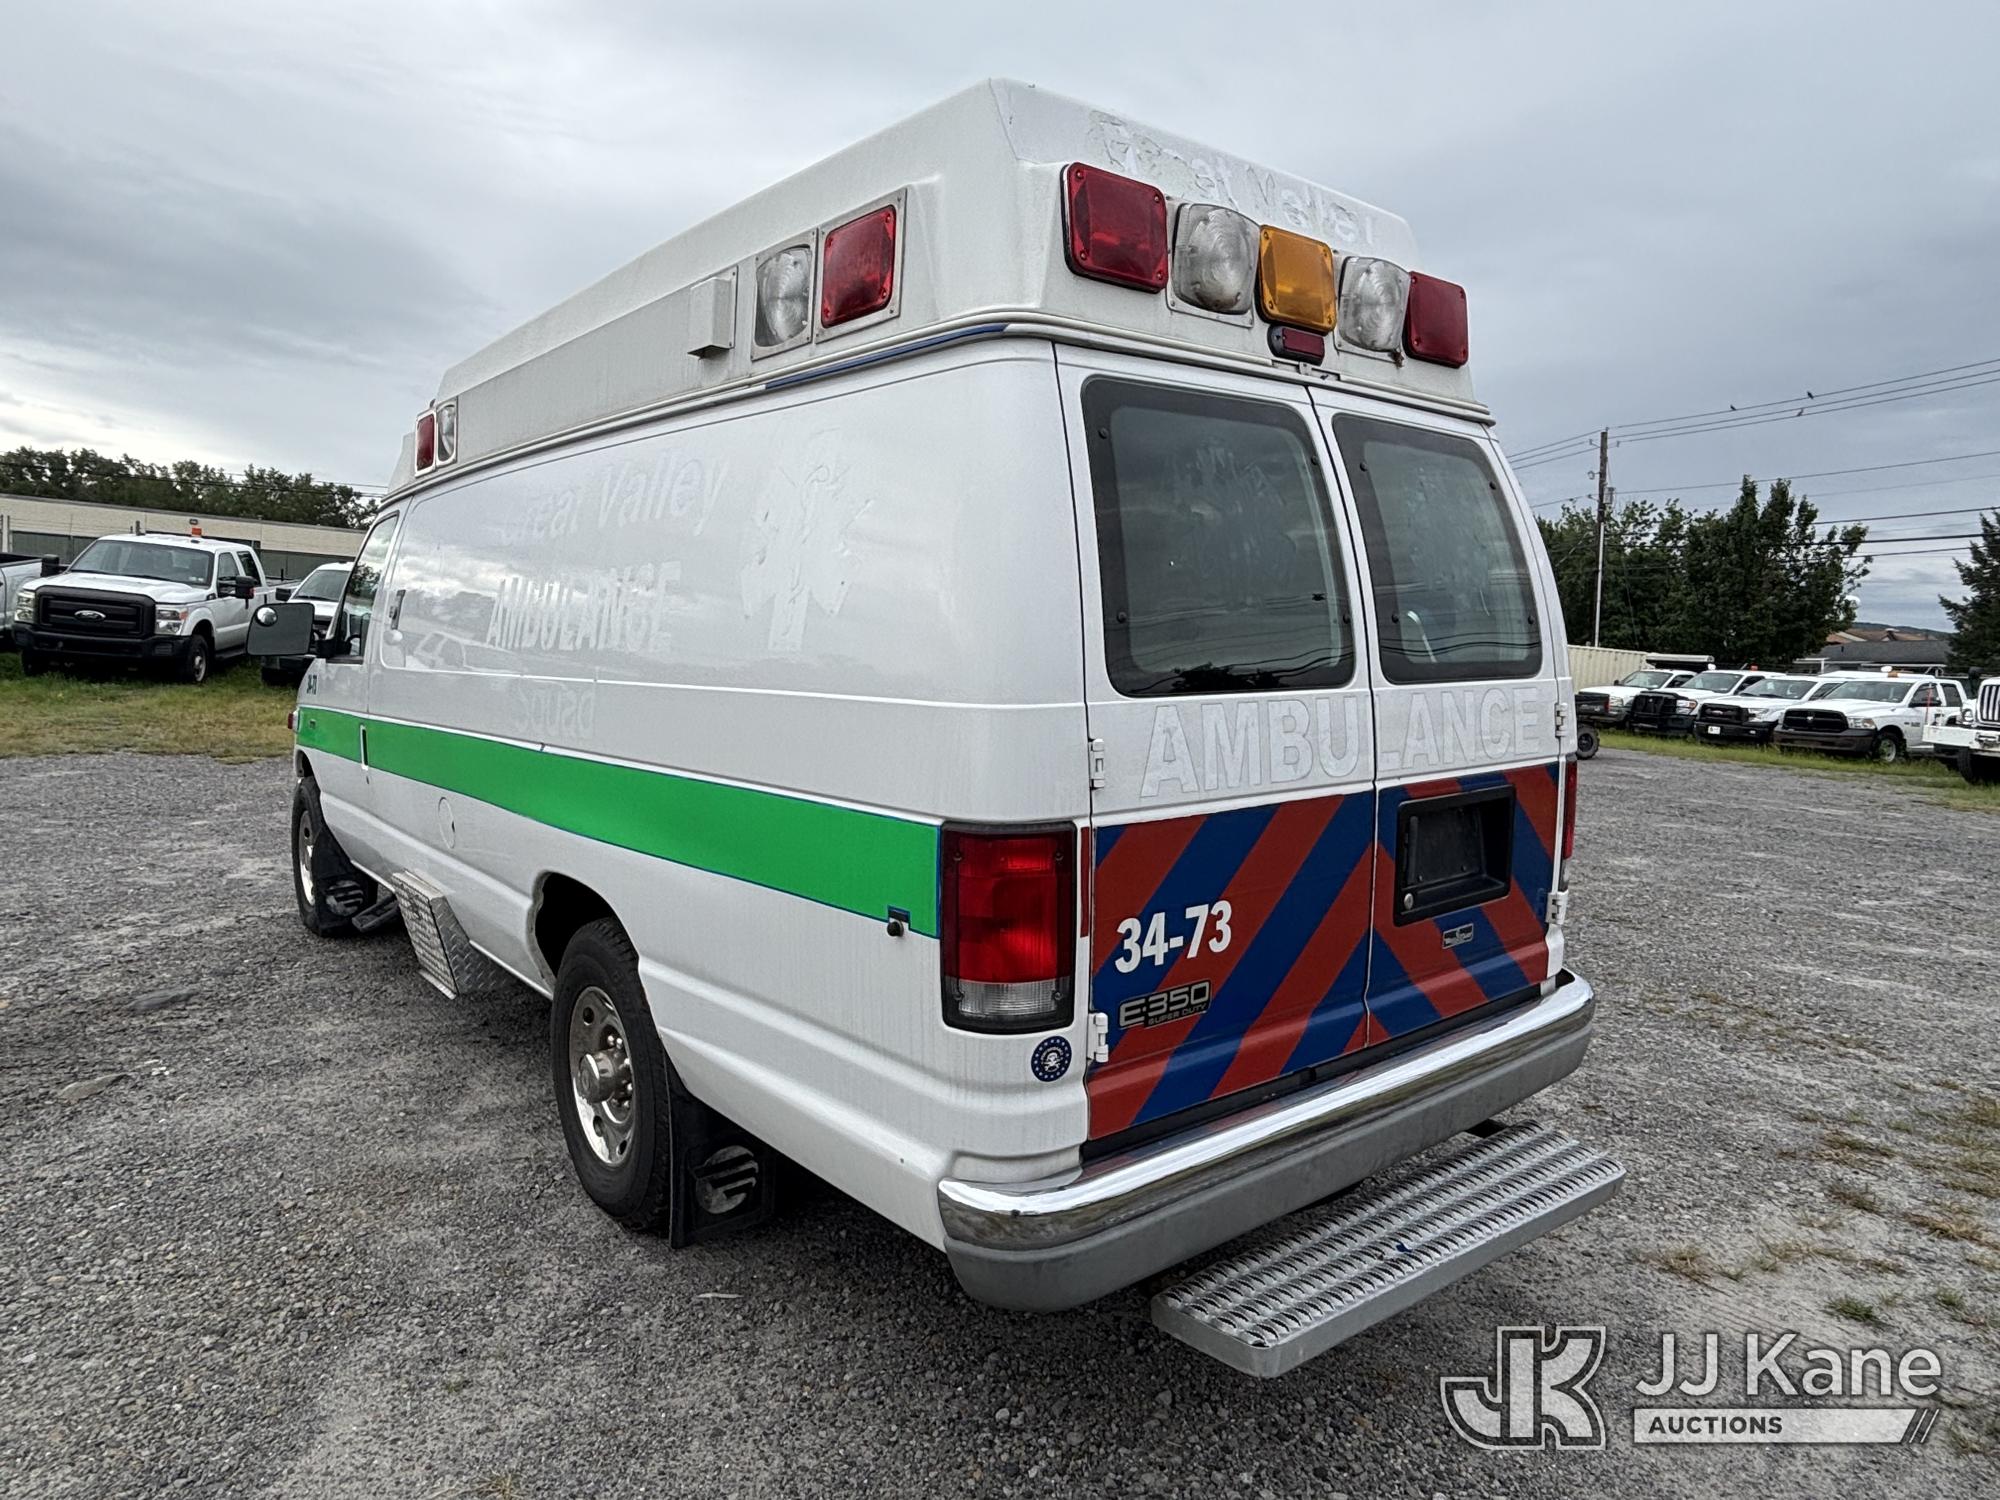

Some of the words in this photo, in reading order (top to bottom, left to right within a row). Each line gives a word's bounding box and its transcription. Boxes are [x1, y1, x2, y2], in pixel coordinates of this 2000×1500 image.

[1141, 687, 1540, 797] AMBULANCE
[1115, 901, 1232, 973] 34-73
[1148, 1012, 1180, 1025] SUPER
[1182, 1003, 1206, 1015] DUTY
